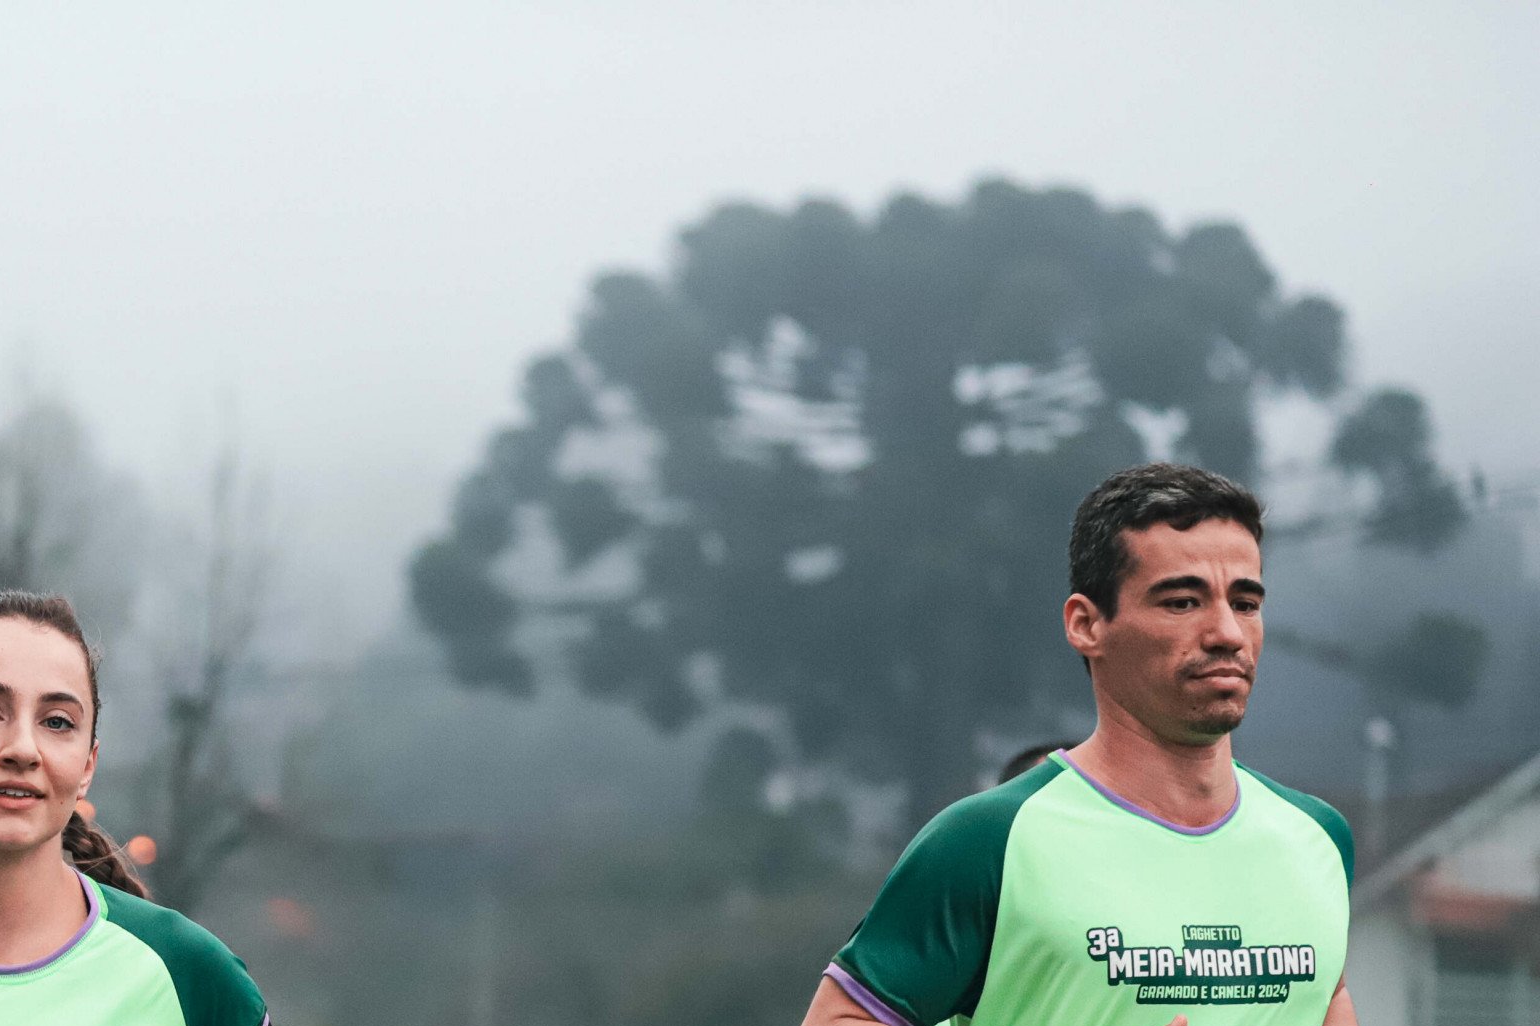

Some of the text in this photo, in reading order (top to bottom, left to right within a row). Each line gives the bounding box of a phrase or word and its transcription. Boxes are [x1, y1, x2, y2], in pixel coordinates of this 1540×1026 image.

[1182, 926, 1241, 941] LAGHETTO
[1138, 983, 1288, 999] GRAMADO E CANELA 2024
